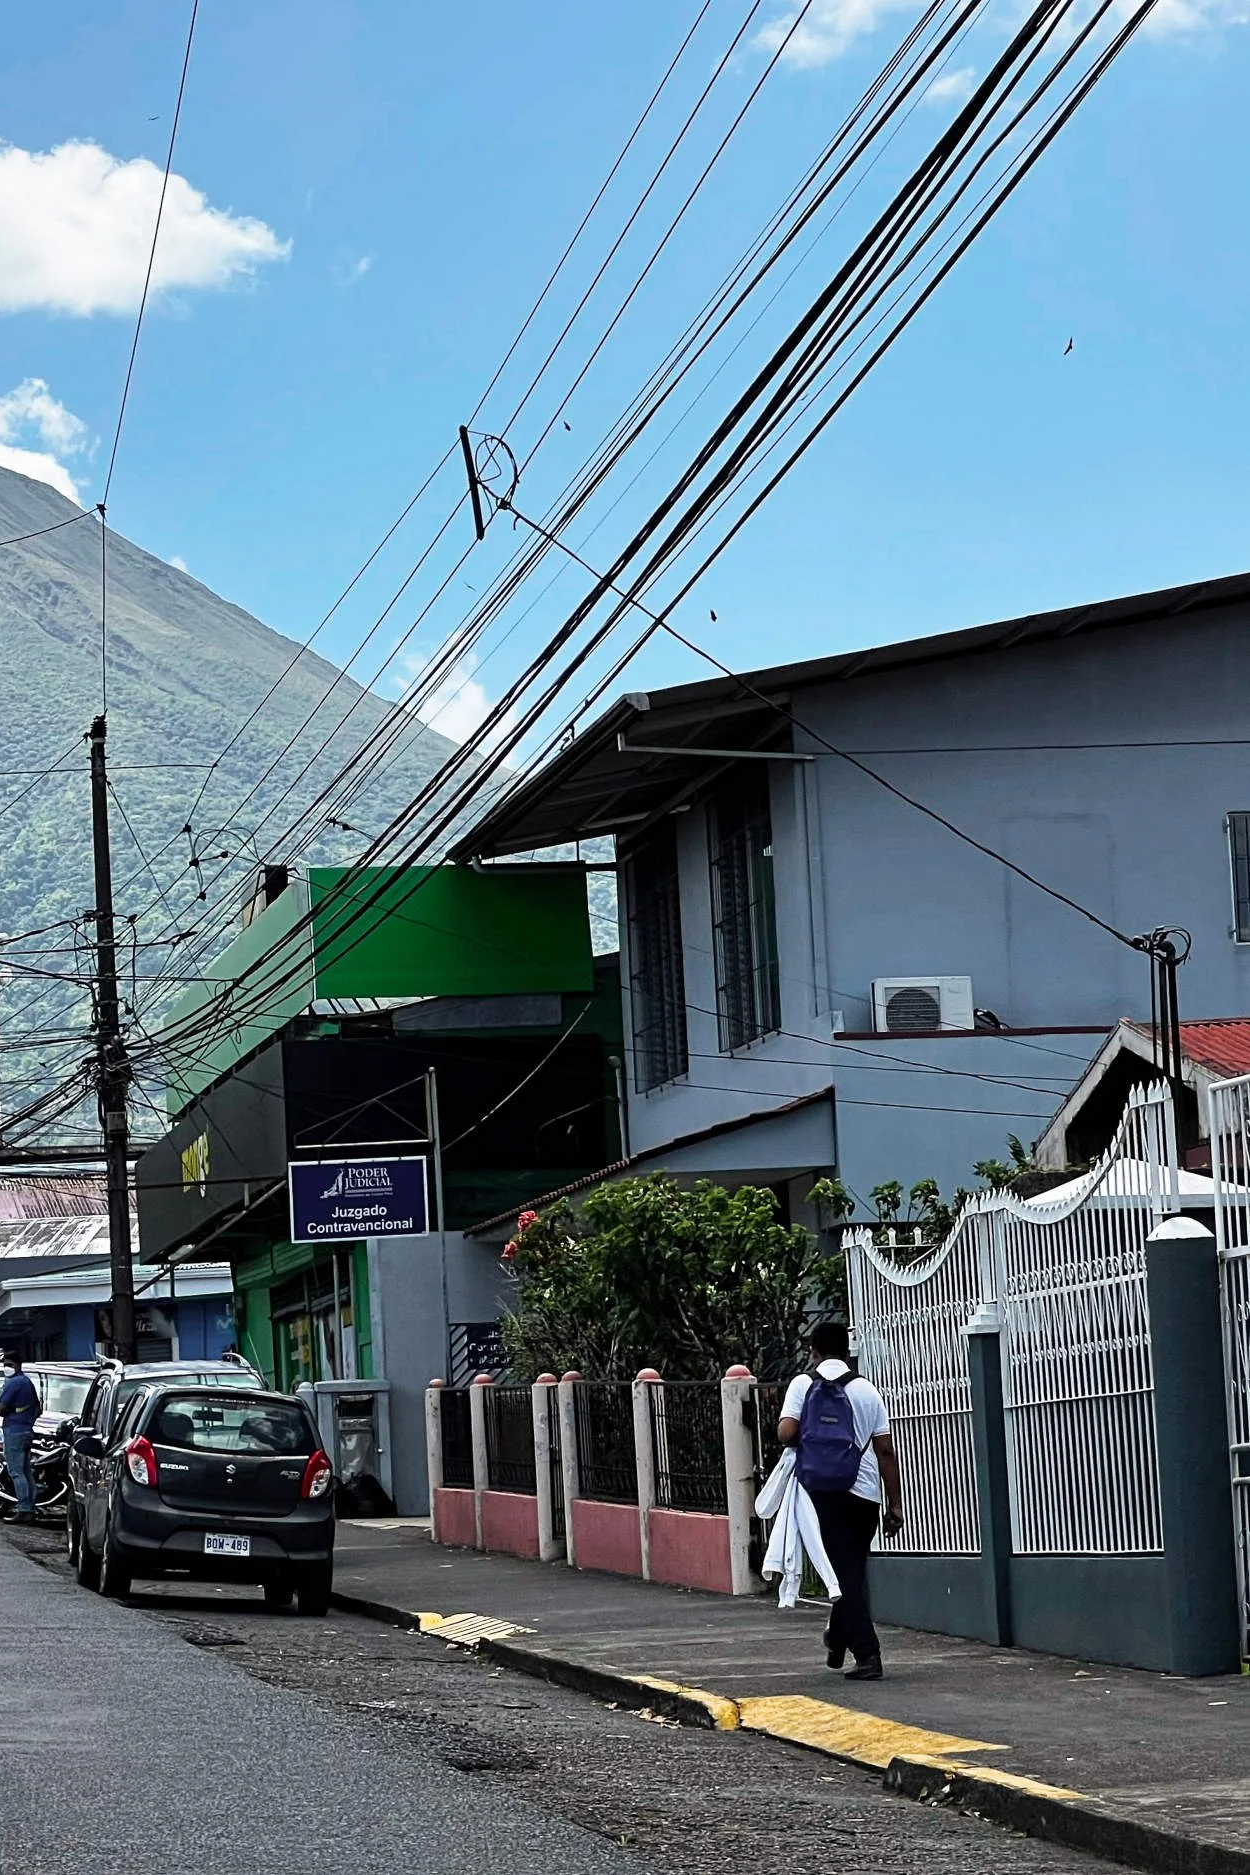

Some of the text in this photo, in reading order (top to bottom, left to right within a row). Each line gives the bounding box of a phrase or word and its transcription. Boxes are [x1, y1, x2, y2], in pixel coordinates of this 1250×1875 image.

[348, 1167, 389, 1179] PODER
[344, 1176, 393, 1190] JUDICIAL
[331, 1204, 388, 1219] Juzgado
[307, 1217, 413, 1234] Contravencional
